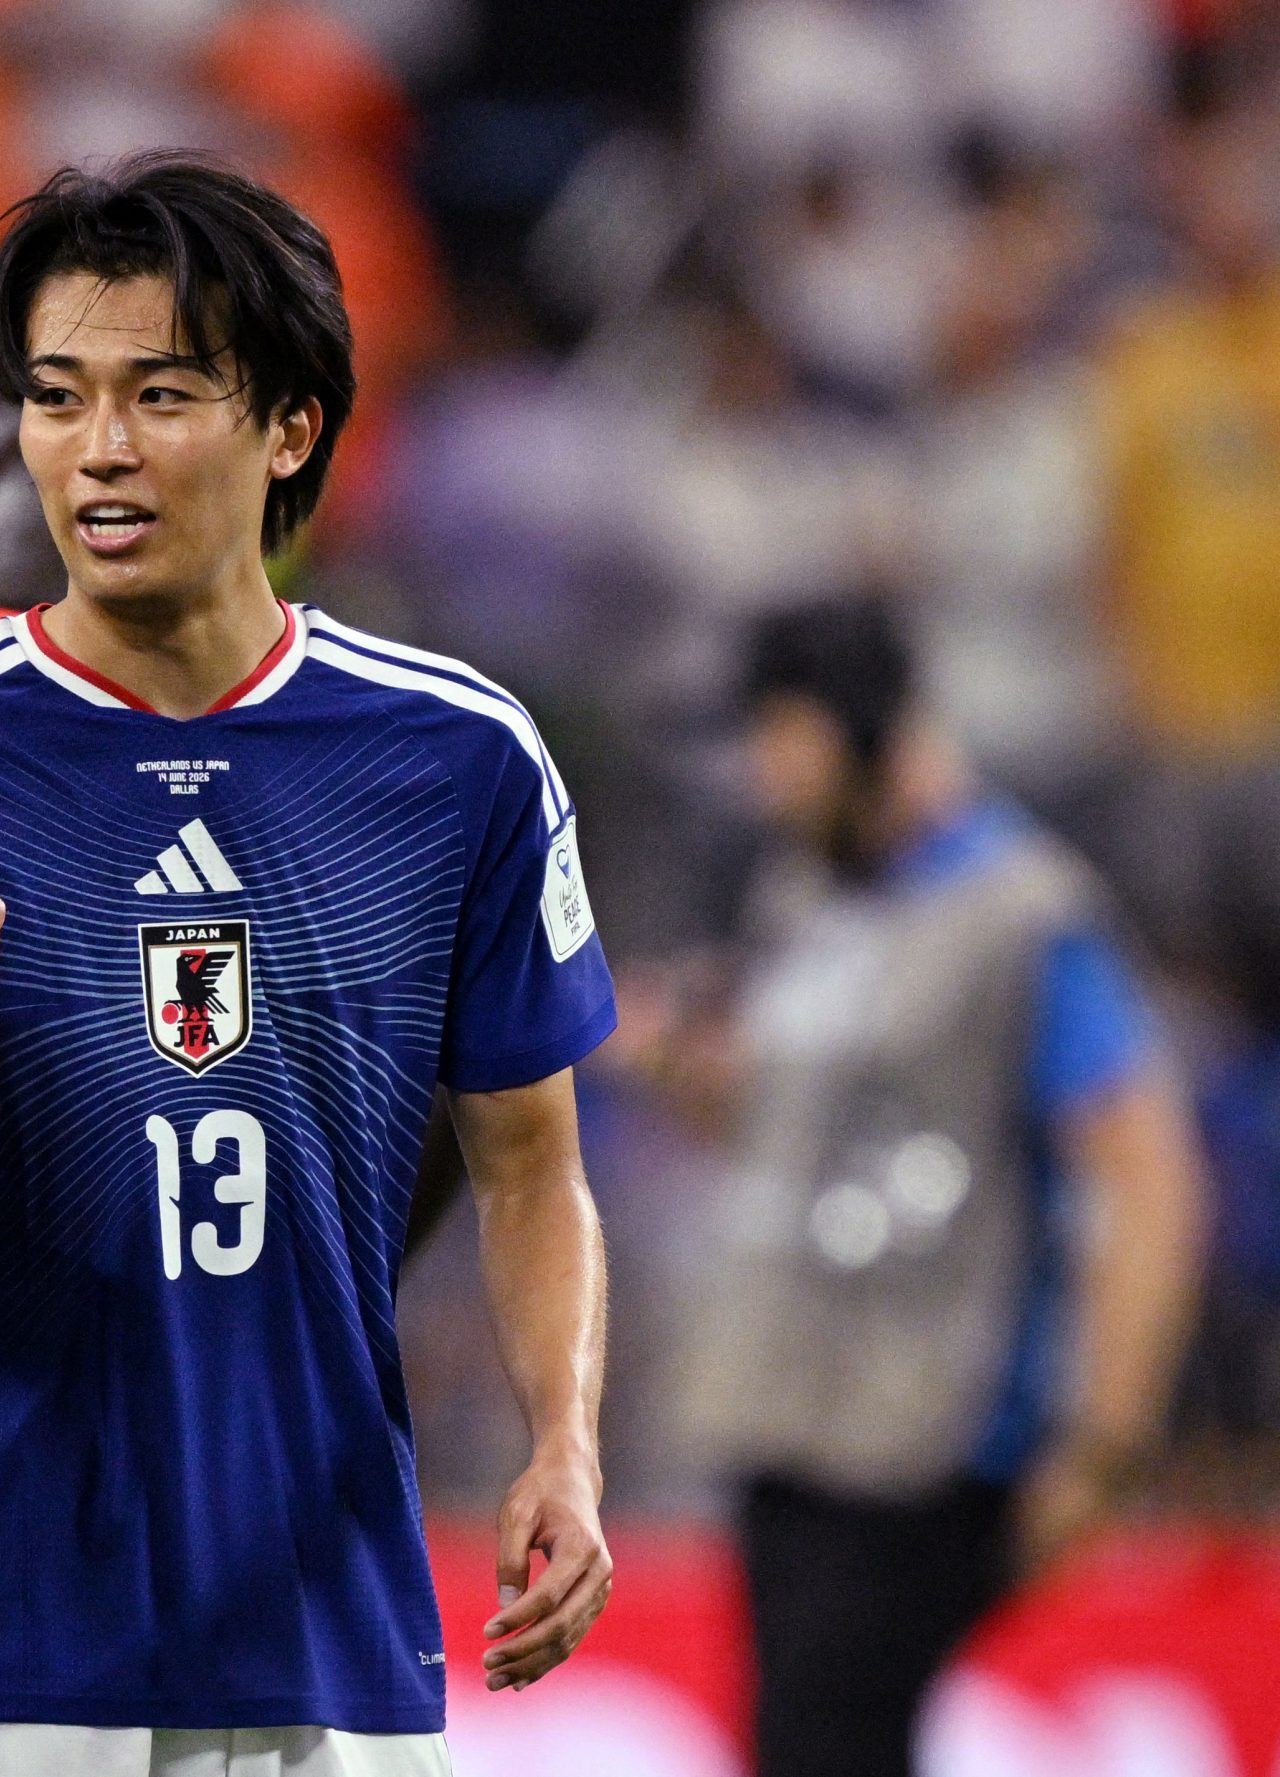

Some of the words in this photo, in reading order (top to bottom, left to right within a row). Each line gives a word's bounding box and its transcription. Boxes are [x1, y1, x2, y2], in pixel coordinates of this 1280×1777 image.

[136, 760, 191, 772] NETHERLANDS
[205, 760, 230, 771] JAPAN
[158, 772, 167, 782] 14
[169, 772, 187, 782] JUNE
[188, 772, 210, 782] 2026
[170, 784, 199, 794] DALLAS
[165, 928, 220, 941] JAPAN
[173, 1024, 220, 1048] JFA
[145, 1109, 267, 1281] 13
